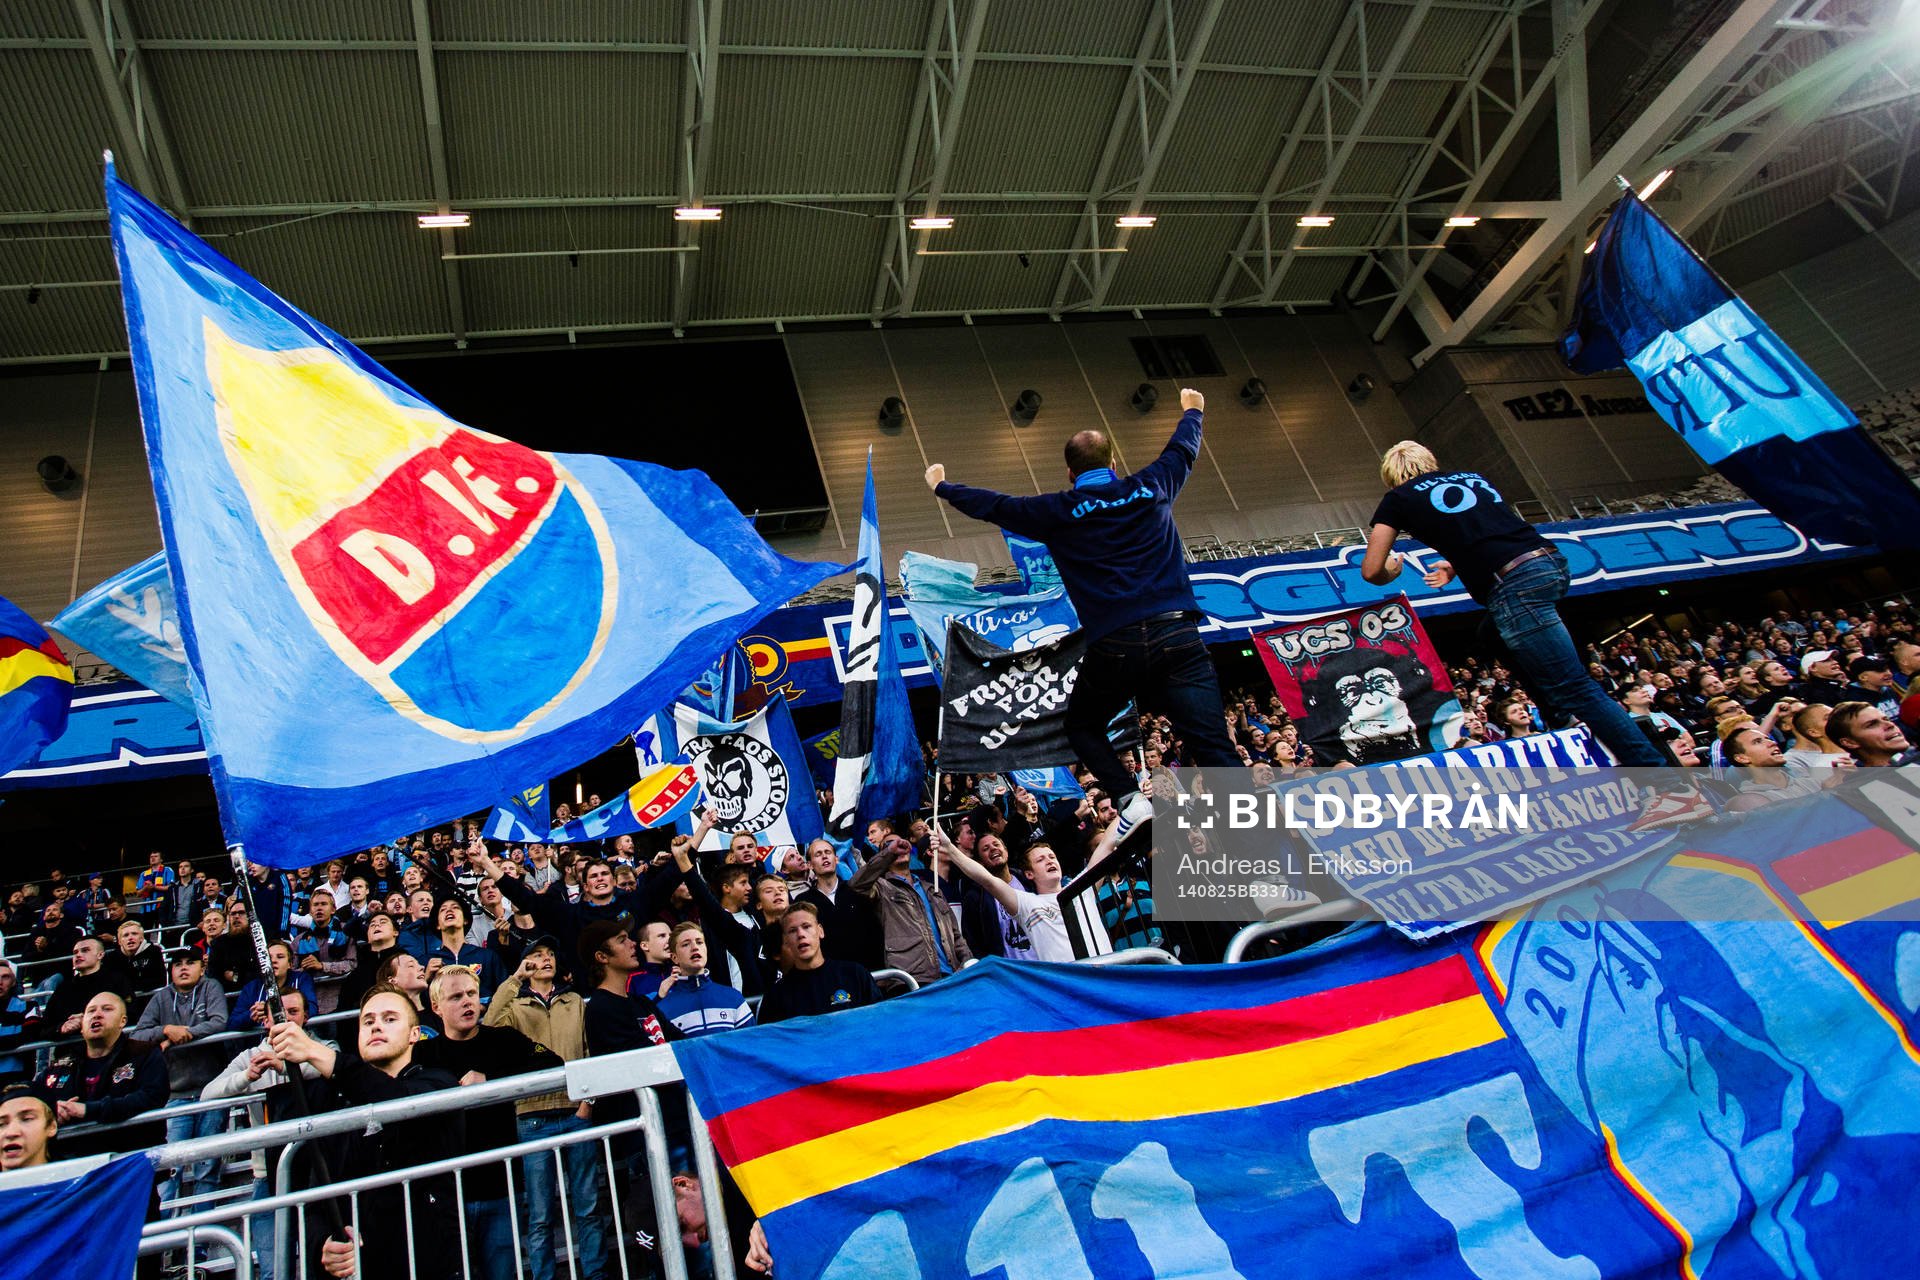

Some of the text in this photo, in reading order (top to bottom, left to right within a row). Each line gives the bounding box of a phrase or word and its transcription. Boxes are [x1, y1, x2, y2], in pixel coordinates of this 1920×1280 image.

[1502, 388, 1587, 422] TELE2
[1266, 603, 1411, 662] UCS 03
[979, 656, 1085, 750] ULTRA
[993, 665, 1059, 714] FÖR
[681, 736, 715, 760] TRA
[723, 764, 787, 833] STOCKHO
[1324, 830, 1412, 881] MED
[1407, 818, 1465, 857] DE
[1375, 866, 1510, 924] ULTRA
[1494, 836, 1594, 885] CAOS
